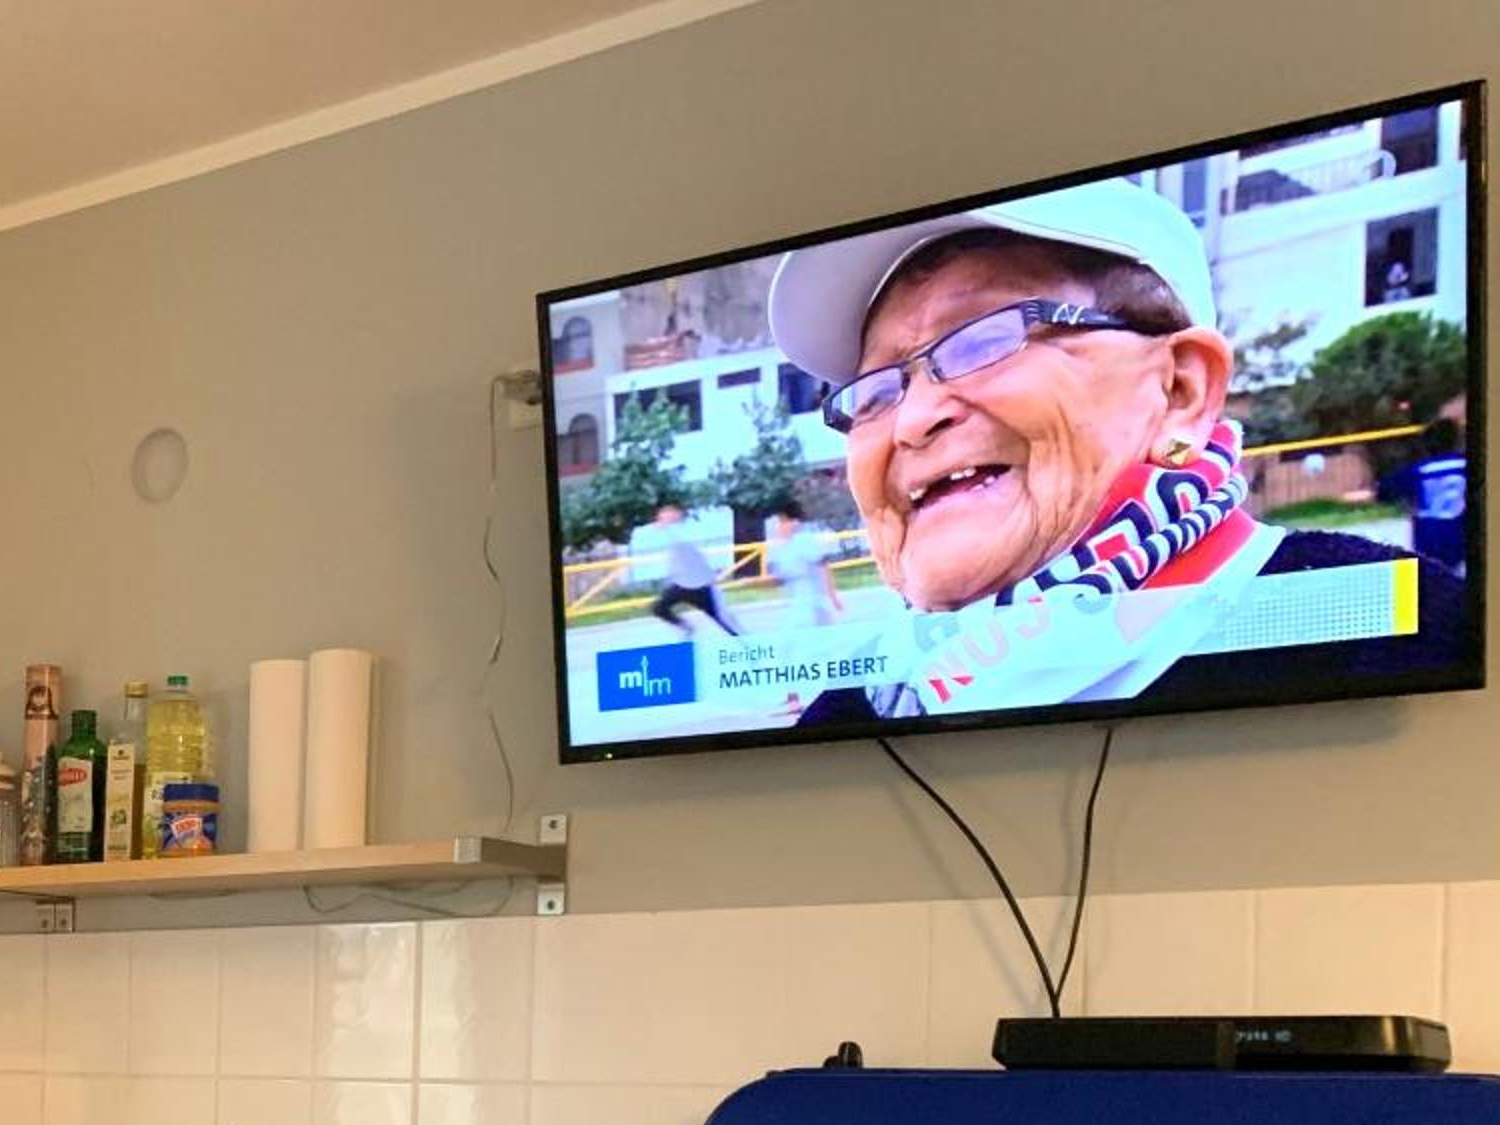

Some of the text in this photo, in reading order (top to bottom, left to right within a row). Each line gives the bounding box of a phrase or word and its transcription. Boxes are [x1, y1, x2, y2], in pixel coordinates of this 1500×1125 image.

[718, 648, 774, 664] Bericht
[719, 655, 889, 689] MATTHIAS EBERT
